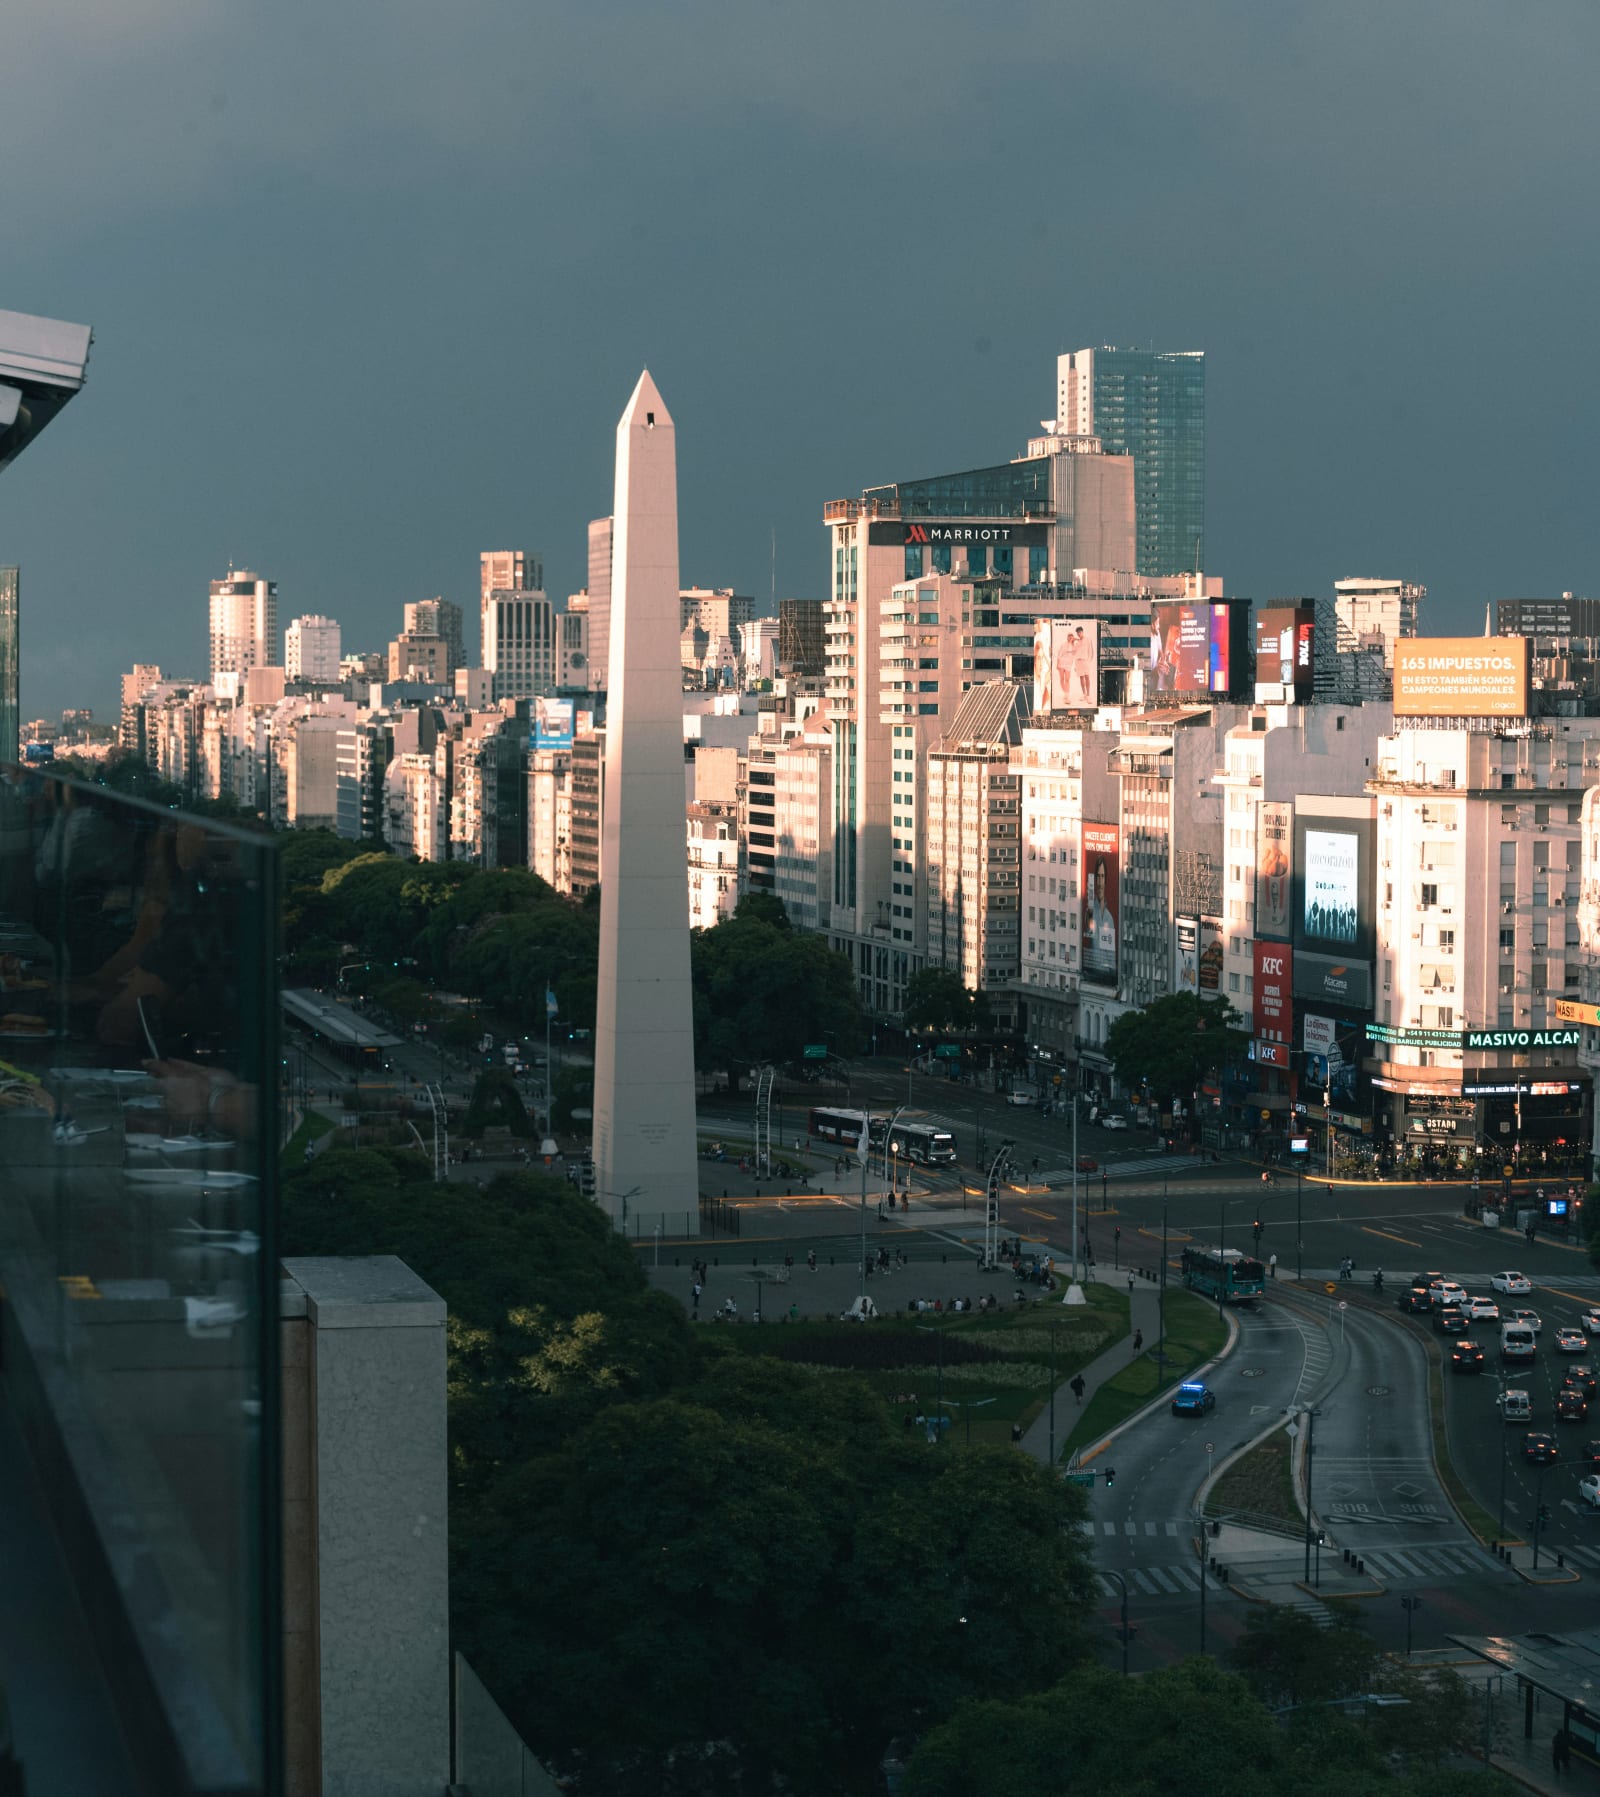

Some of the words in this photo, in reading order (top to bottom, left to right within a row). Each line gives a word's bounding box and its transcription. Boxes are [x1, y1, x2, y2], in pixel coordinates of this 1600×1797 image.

[931, 529, 1010, 540] MARRIOTT
[1401, 657, 1426, 670] 165
[1428, 657, 1516, 670] IMPUESTOS.
[1401, 676, 1414, 685] EN
[1415, 676, 1438, 685] ESTO
[1440, 674, 1480, 685] TAMBIÉN
[1481, 676, 1516, 685] SOMOS
[1401, 685, 1459, 694] CAMPEONES
[1460, 685, 1516, 695] MUNDIALES.
[1262, 957, 1283, 976] KFC
[1323, 975, 1348, 989] Atacama
[1557, 1002, 1570, 1017] MÁS
[1397, 1038, 1424, 1046] BARUJEL
[1424, 1039, 1462, 1048] PUBLICIDAD
[1469, 1032, 1530, 1047] MASIVO
[1261, 1046, 1277, 1060] KFC
[1424, 1119, 1457, 1130] OSTADO
[1331, 1503, 1369, 1513] BUS
[1400, 1503, 1437, 1513] BUS
